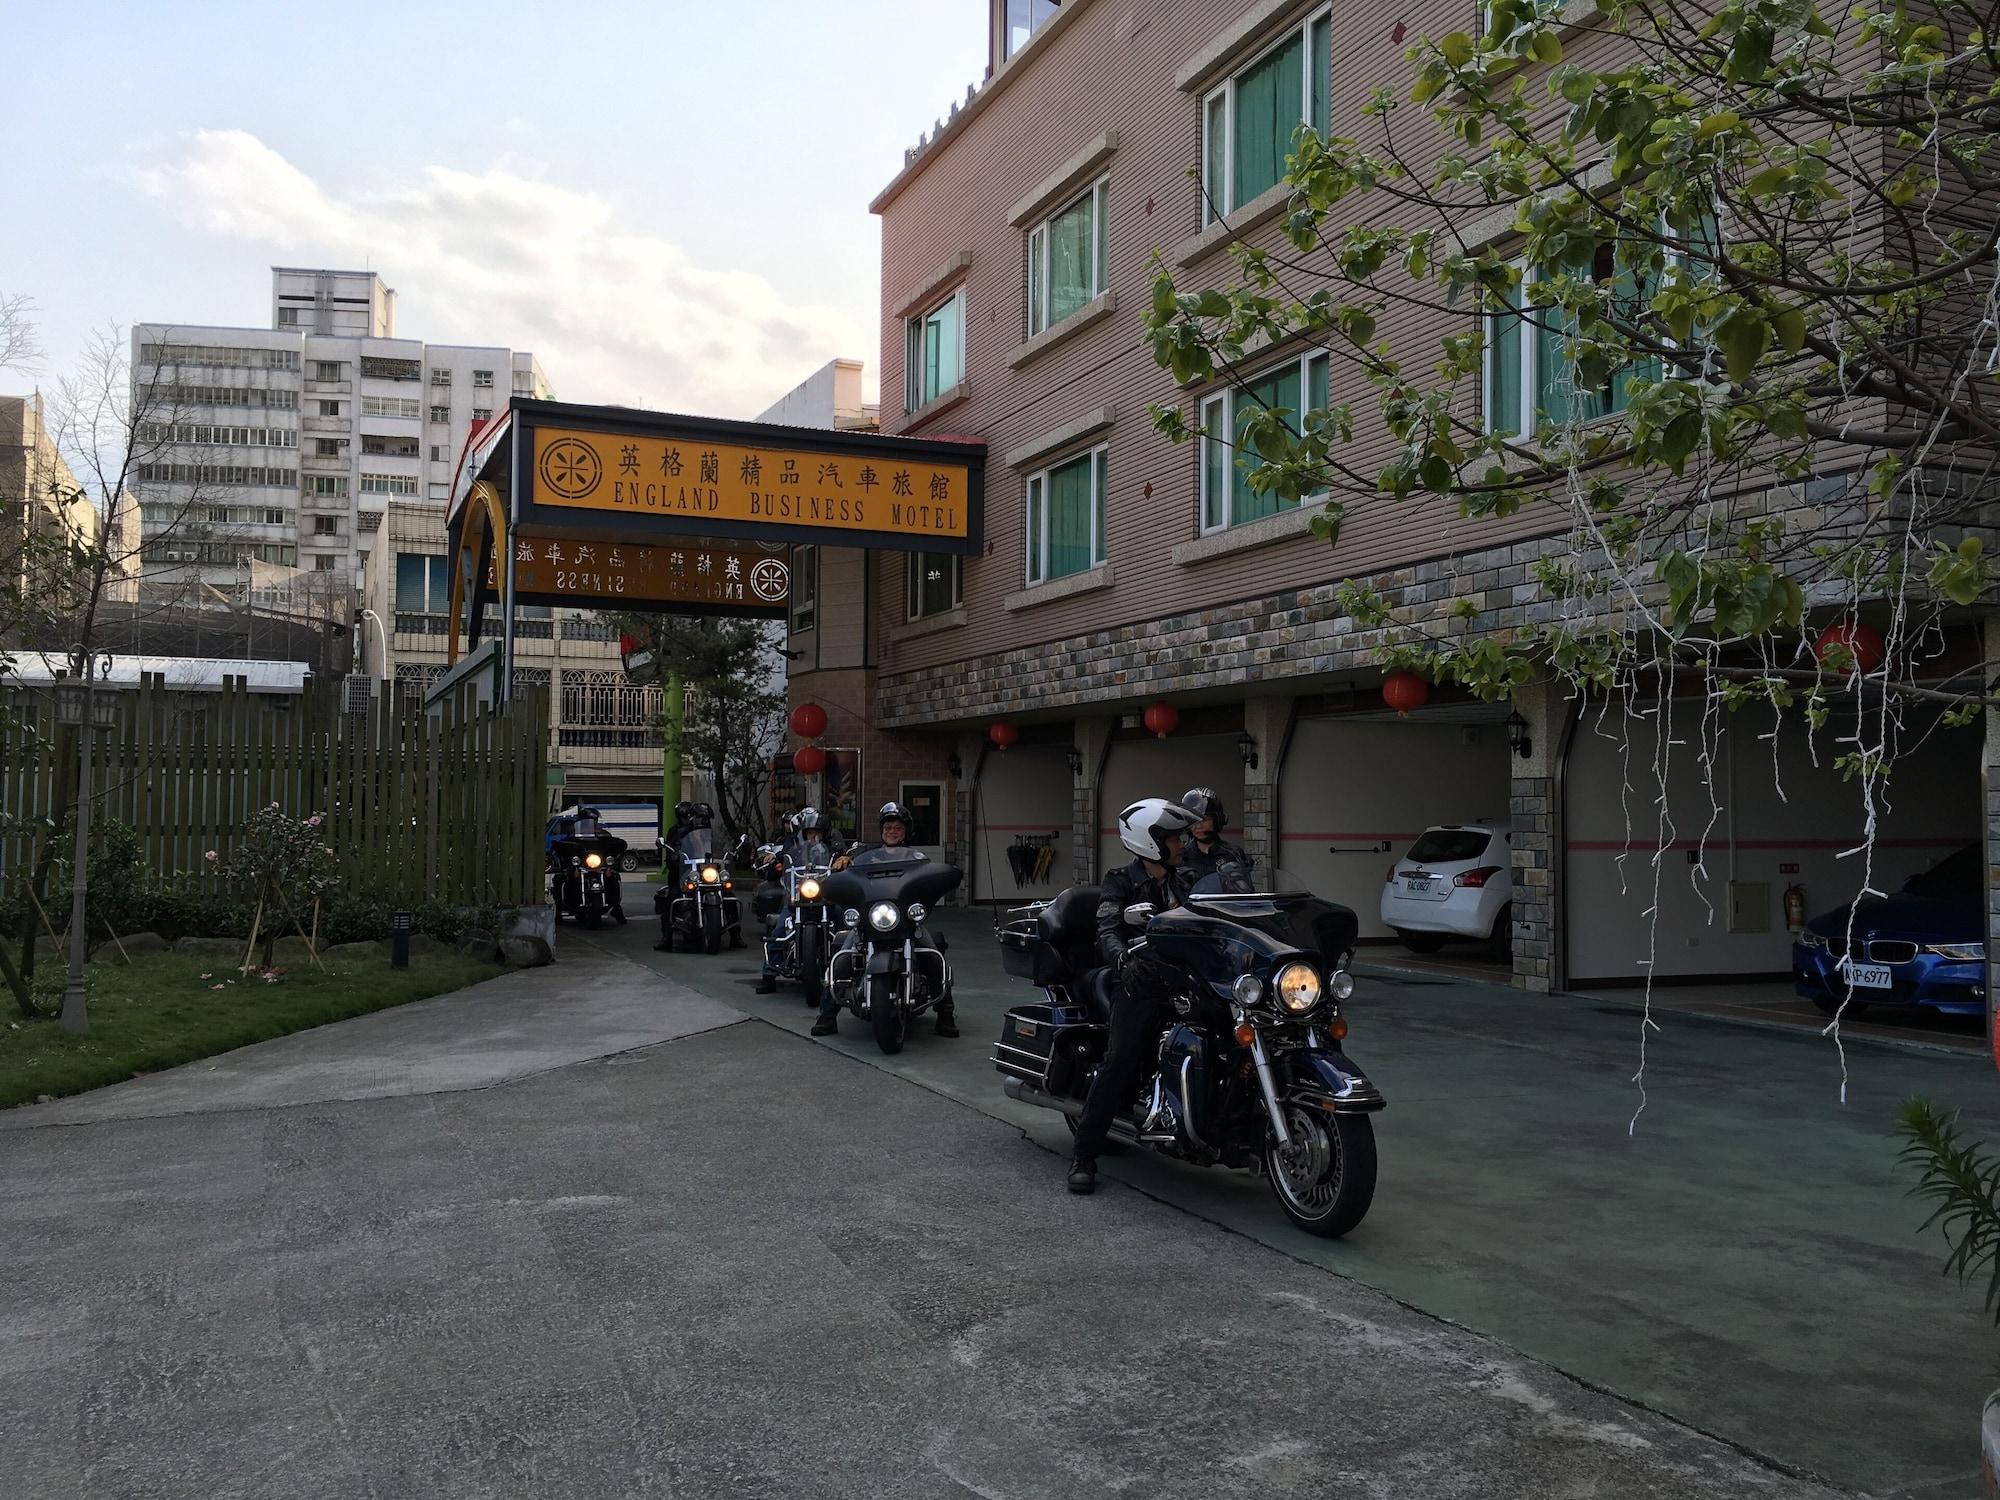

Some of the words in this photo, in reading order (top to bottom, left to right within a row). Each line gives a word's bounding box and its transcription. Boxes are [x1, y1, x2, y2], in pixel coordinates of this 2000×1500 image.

[618, 443, 950, 501] 英格蘭精品汽車旅館
[614, 481, 719, 511] ENGLAND
[750, 492, 864, 522] BUSINESS
[892, 503, 958, 530] MOTEL
